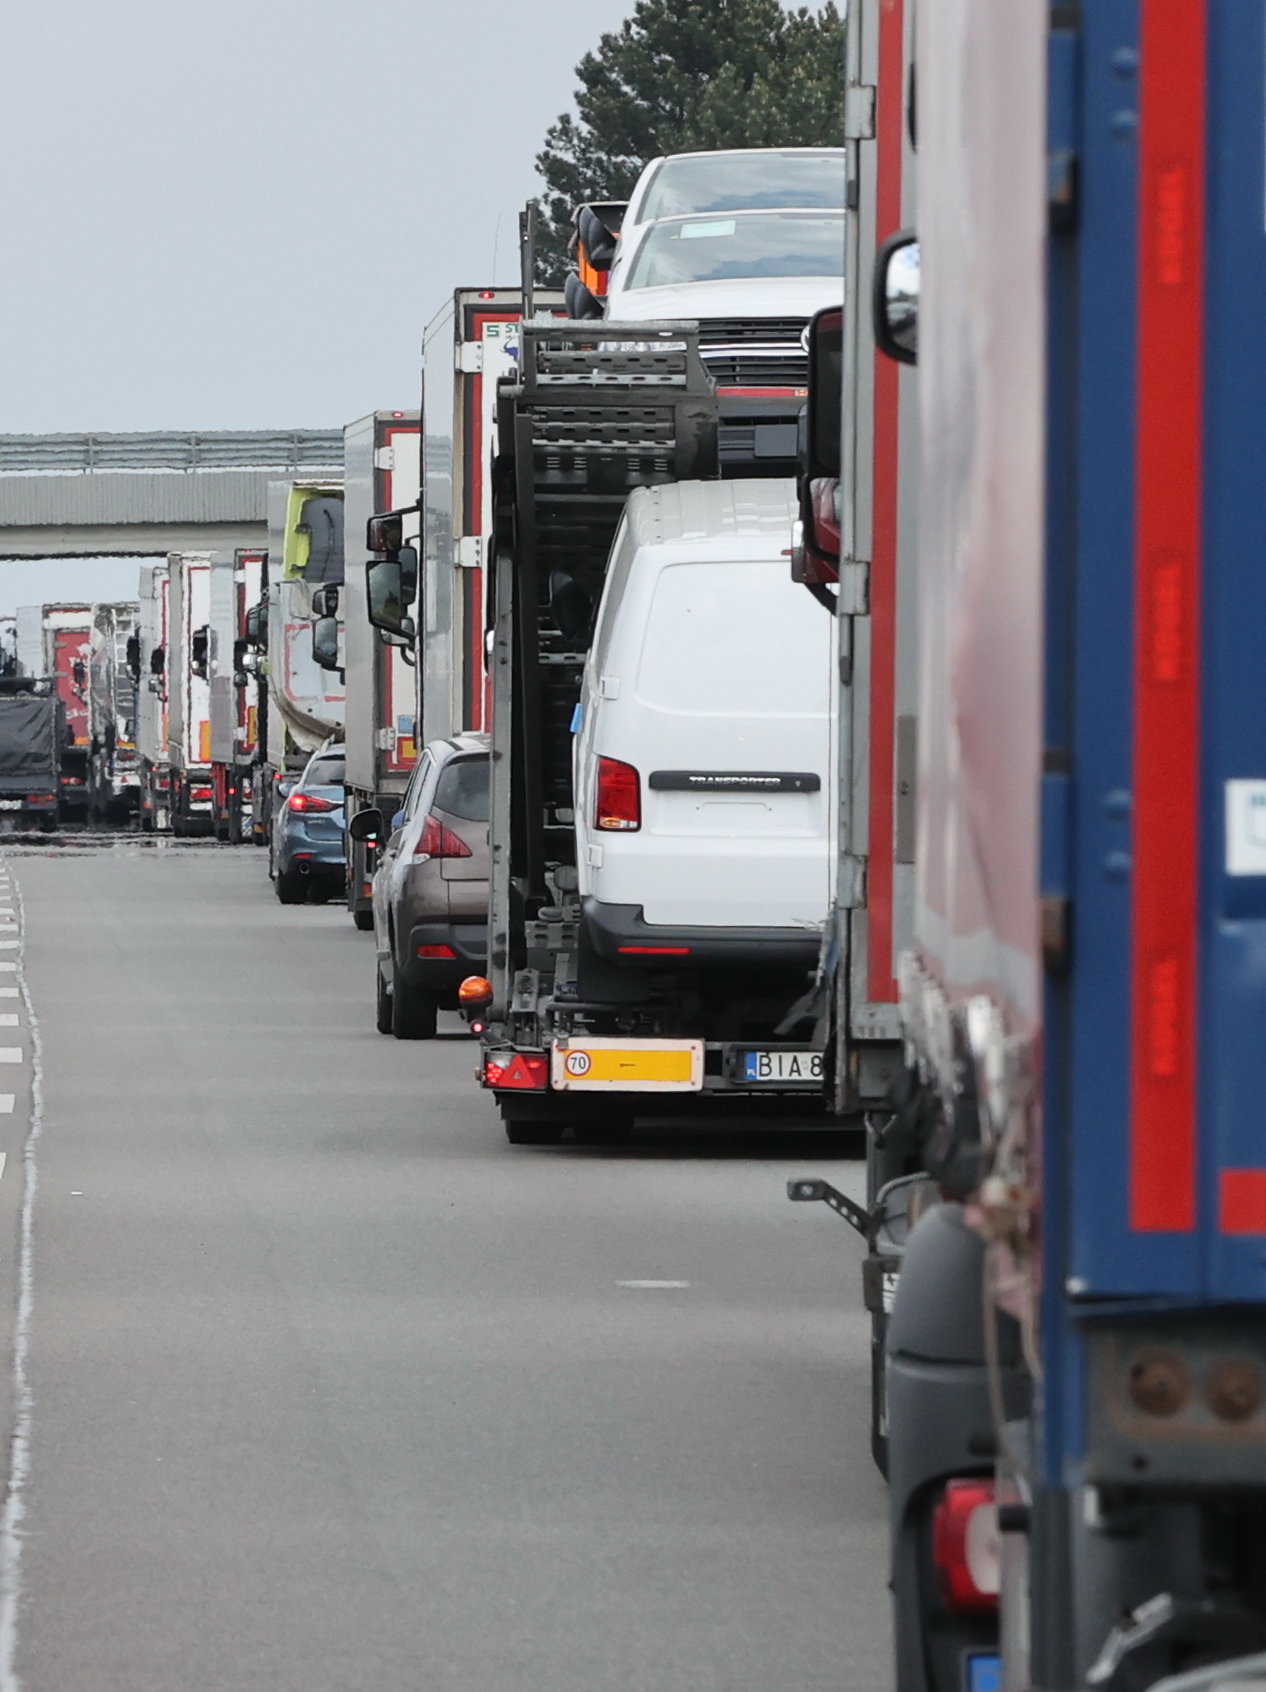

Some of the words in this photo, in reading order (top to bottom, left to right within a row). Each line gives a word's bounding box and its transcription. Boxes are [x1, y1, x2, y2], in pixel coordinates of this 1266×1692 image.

[689, 776, 781, 786] TRANSPORTER
[570, 1056, 586, 1070] 70
[759, 1053, 802, 1077] BIA
